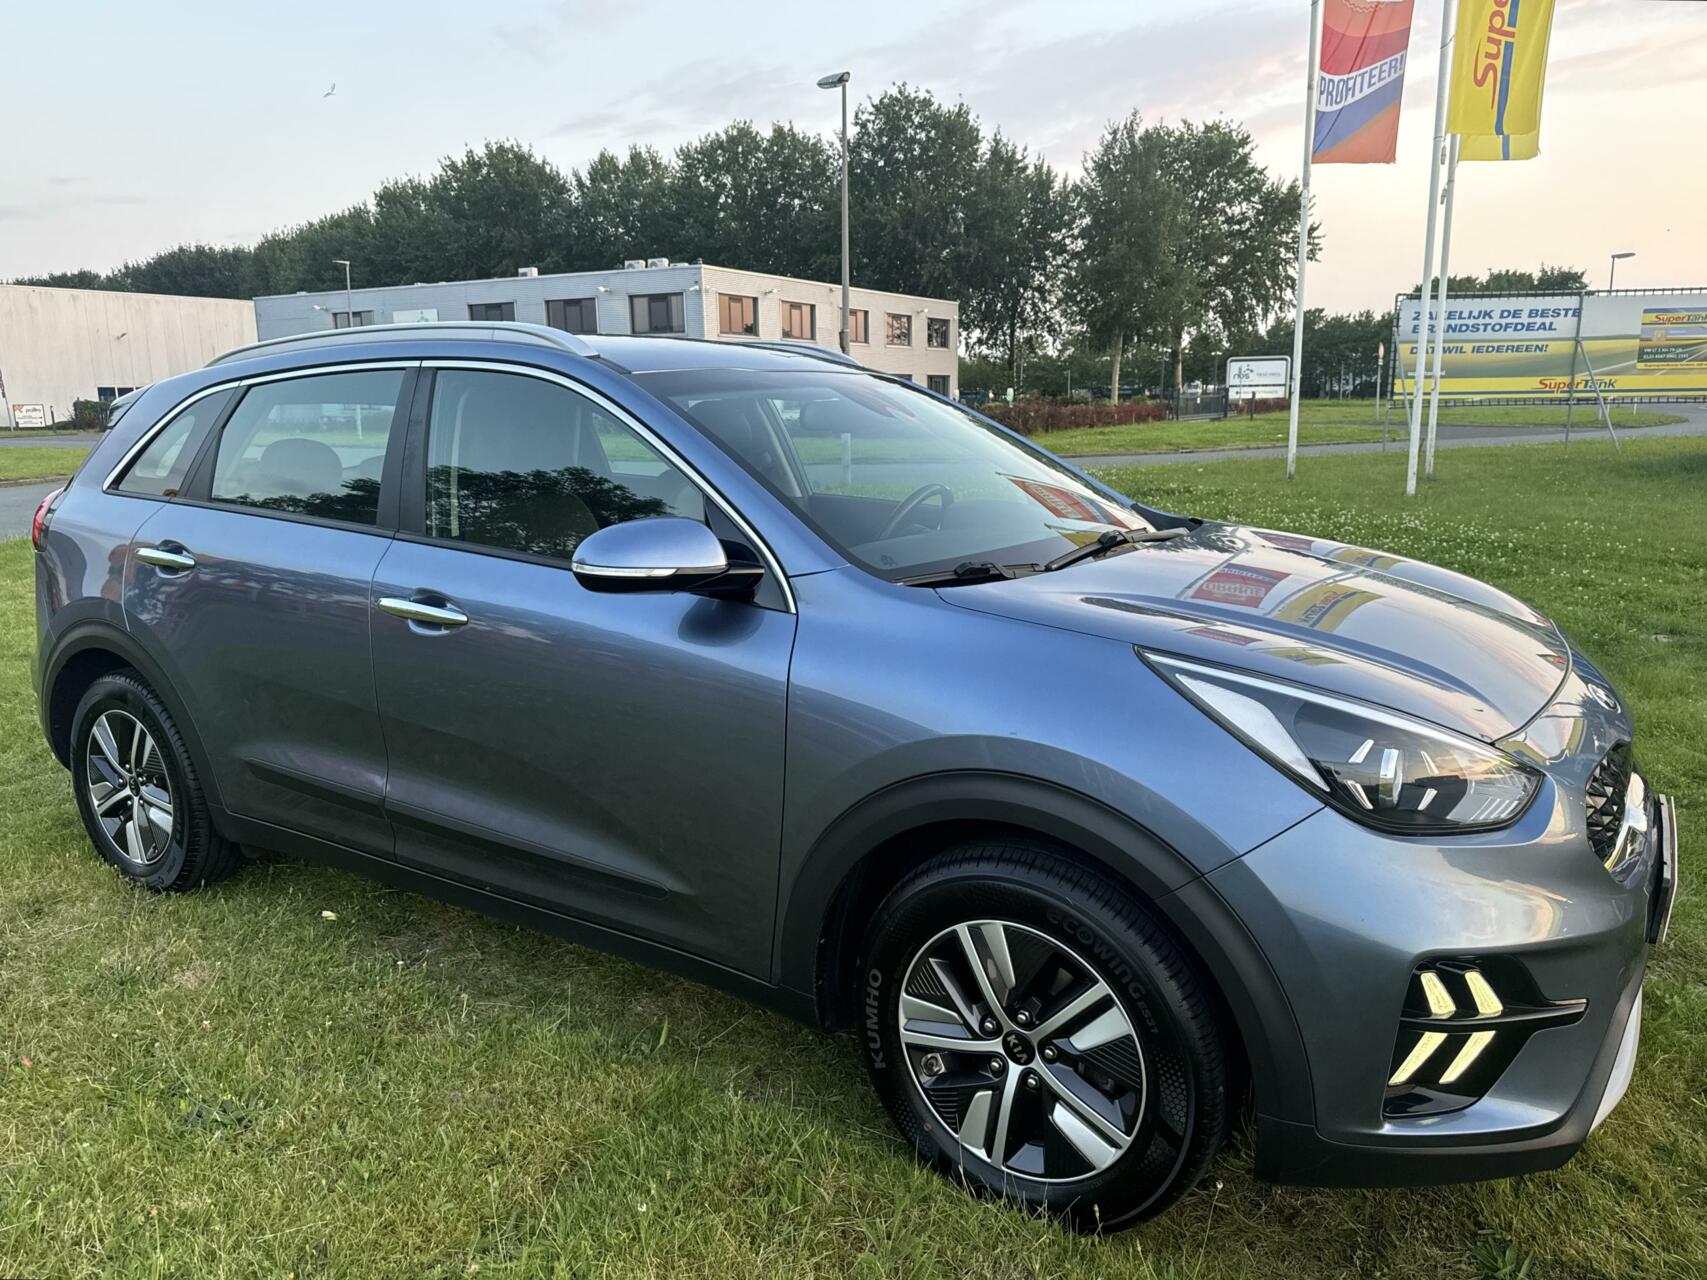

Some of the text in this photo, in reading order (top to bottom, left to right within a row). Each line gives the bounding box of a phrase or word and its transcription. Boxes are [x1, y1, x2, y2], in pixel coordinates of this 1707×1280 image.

[1318, 54, 1405, 107] PROFITEER!
[1499, 309, 1523, 319] DE
[1528, 307, 1581, 318] BESTE
[1412, 321, 1557, 334] BRNDSTOFDEAL
[1442, 345, 1466, 354] WIL
[1471, 344, 1549, 354] IEDEREEN!
[865, 968, 887, 1069] KUMHO
[1007, 1034, 1028, 1063] KIA
